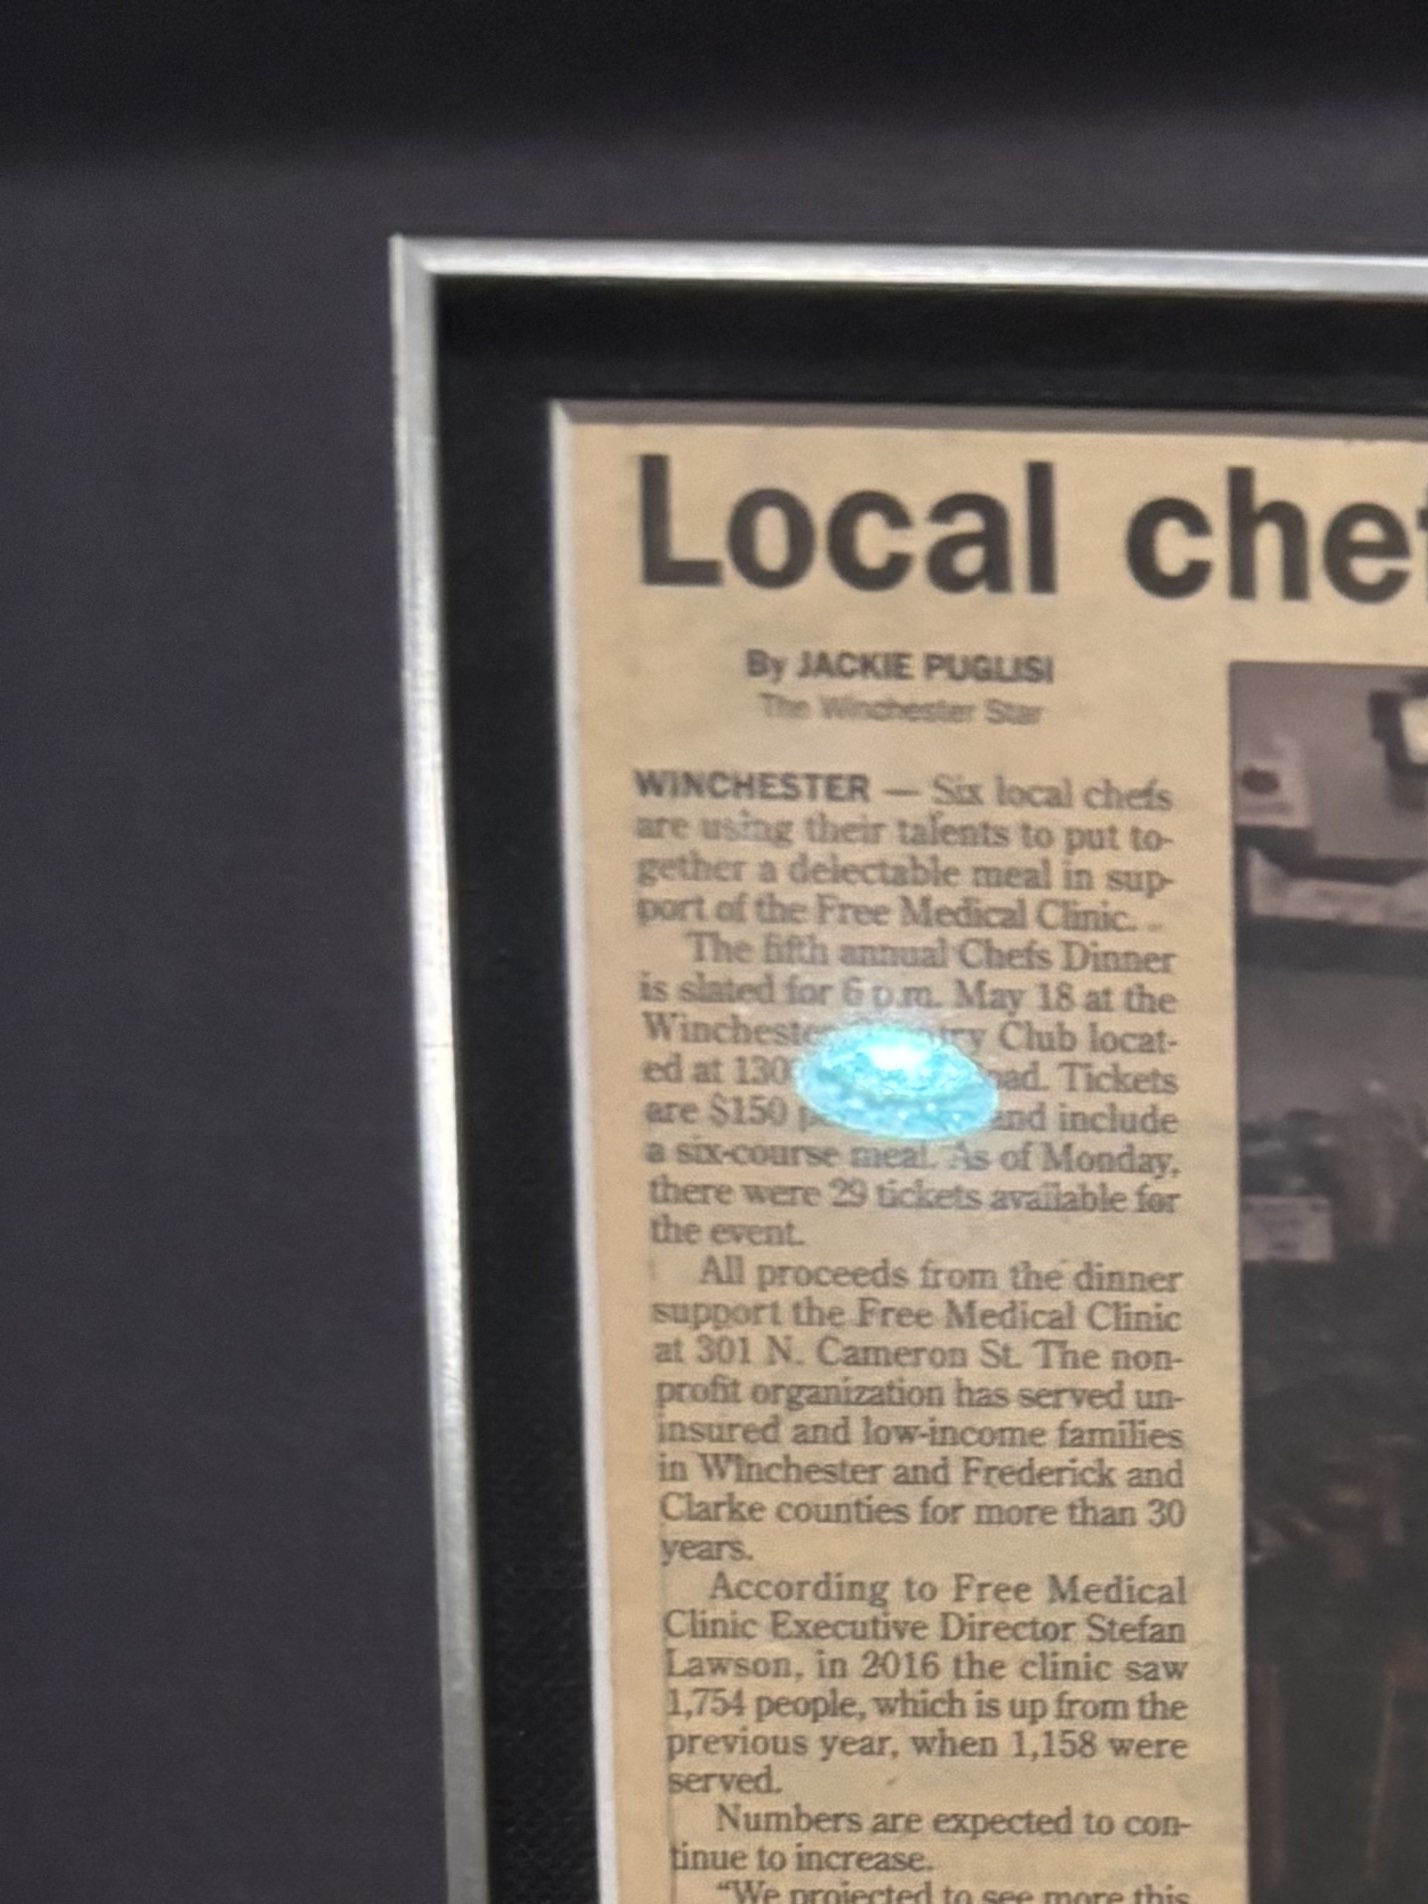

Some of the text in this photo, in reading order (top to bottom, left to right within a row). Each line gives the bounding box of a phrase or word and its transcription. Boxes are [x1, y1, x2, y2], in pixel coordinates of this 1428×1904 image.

[636, 452, 1058, 596] Local
[746, 648, 1054, 684] By JACKIE PUGLISI
[634, 769, 871, 803] WINCHESTER
[932, 777, 984, 806] Six
[995, 775, 1073, 809] local
[1083, 778, 1174, 812] chefs
[658, 1490, 1187, 1529] Clarke counties for more than 30
[706, 1568, 1190, 1608] According to Free Medical
